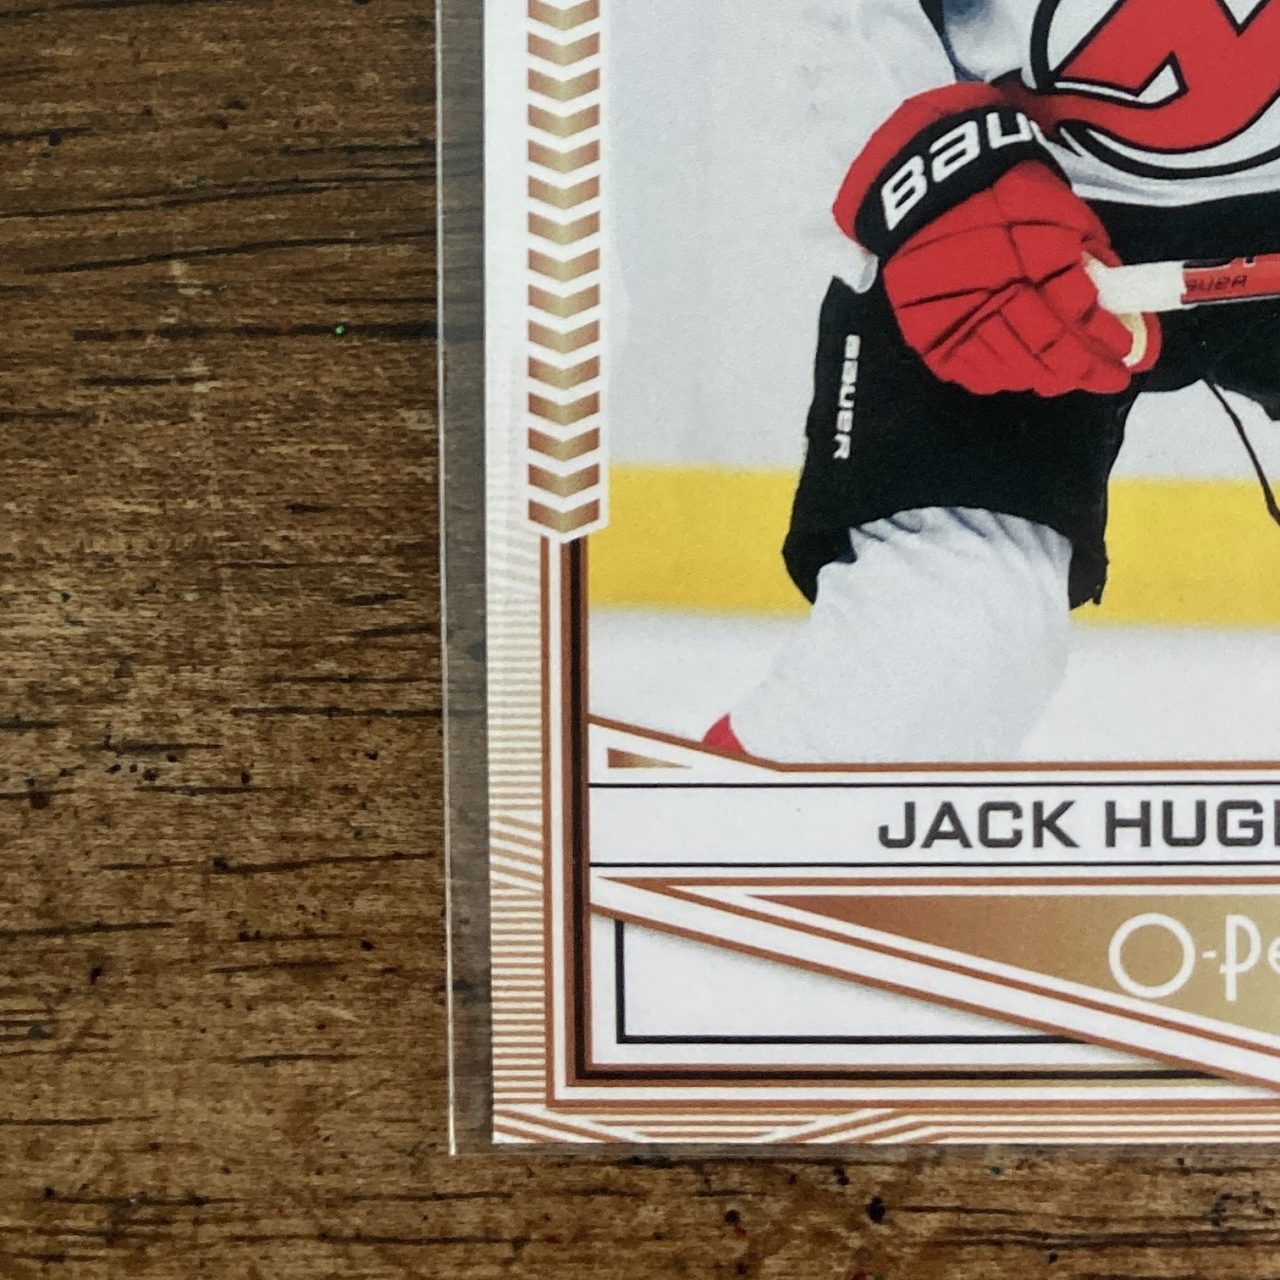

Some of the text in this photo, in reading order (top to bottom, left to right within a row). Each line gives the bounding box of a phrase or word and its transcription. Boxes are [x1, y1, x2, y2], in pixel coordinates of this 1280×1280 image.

[880, 111, 1034, 232] BAU
[1184, 273, 1249, 297] AUER
[832, 333, 862, 460] BAUER
[877, 800, 1081, 849] JACK
